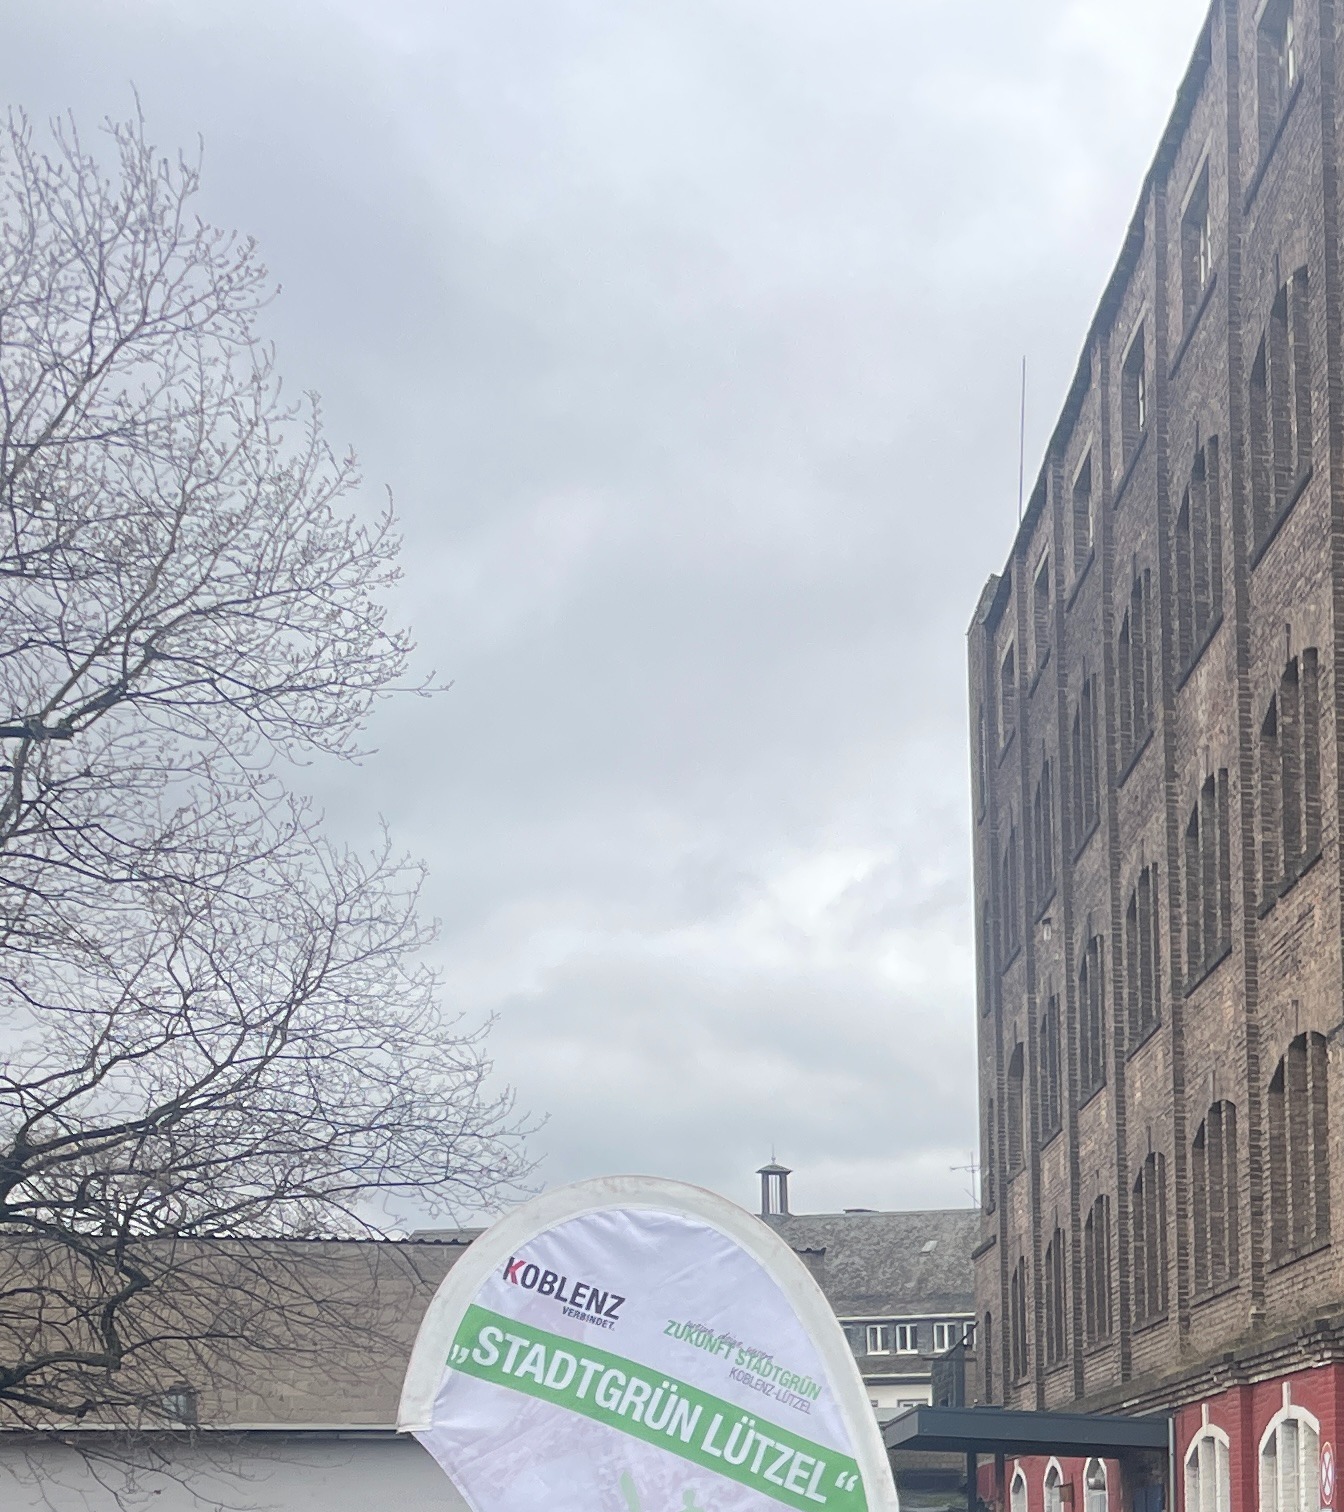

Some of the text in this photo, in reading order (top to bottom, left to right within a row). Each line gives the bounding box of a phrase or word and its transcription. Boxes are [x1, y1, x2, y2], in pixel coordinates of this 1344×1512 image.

[503, 1257, 626, 1321] KOBLENZ
[662, 1319, 823, 1401] ZUKUNFT STADTGRÜN
[728, 1366, 813, 1416] KOBLENZ-LÜTZEL
